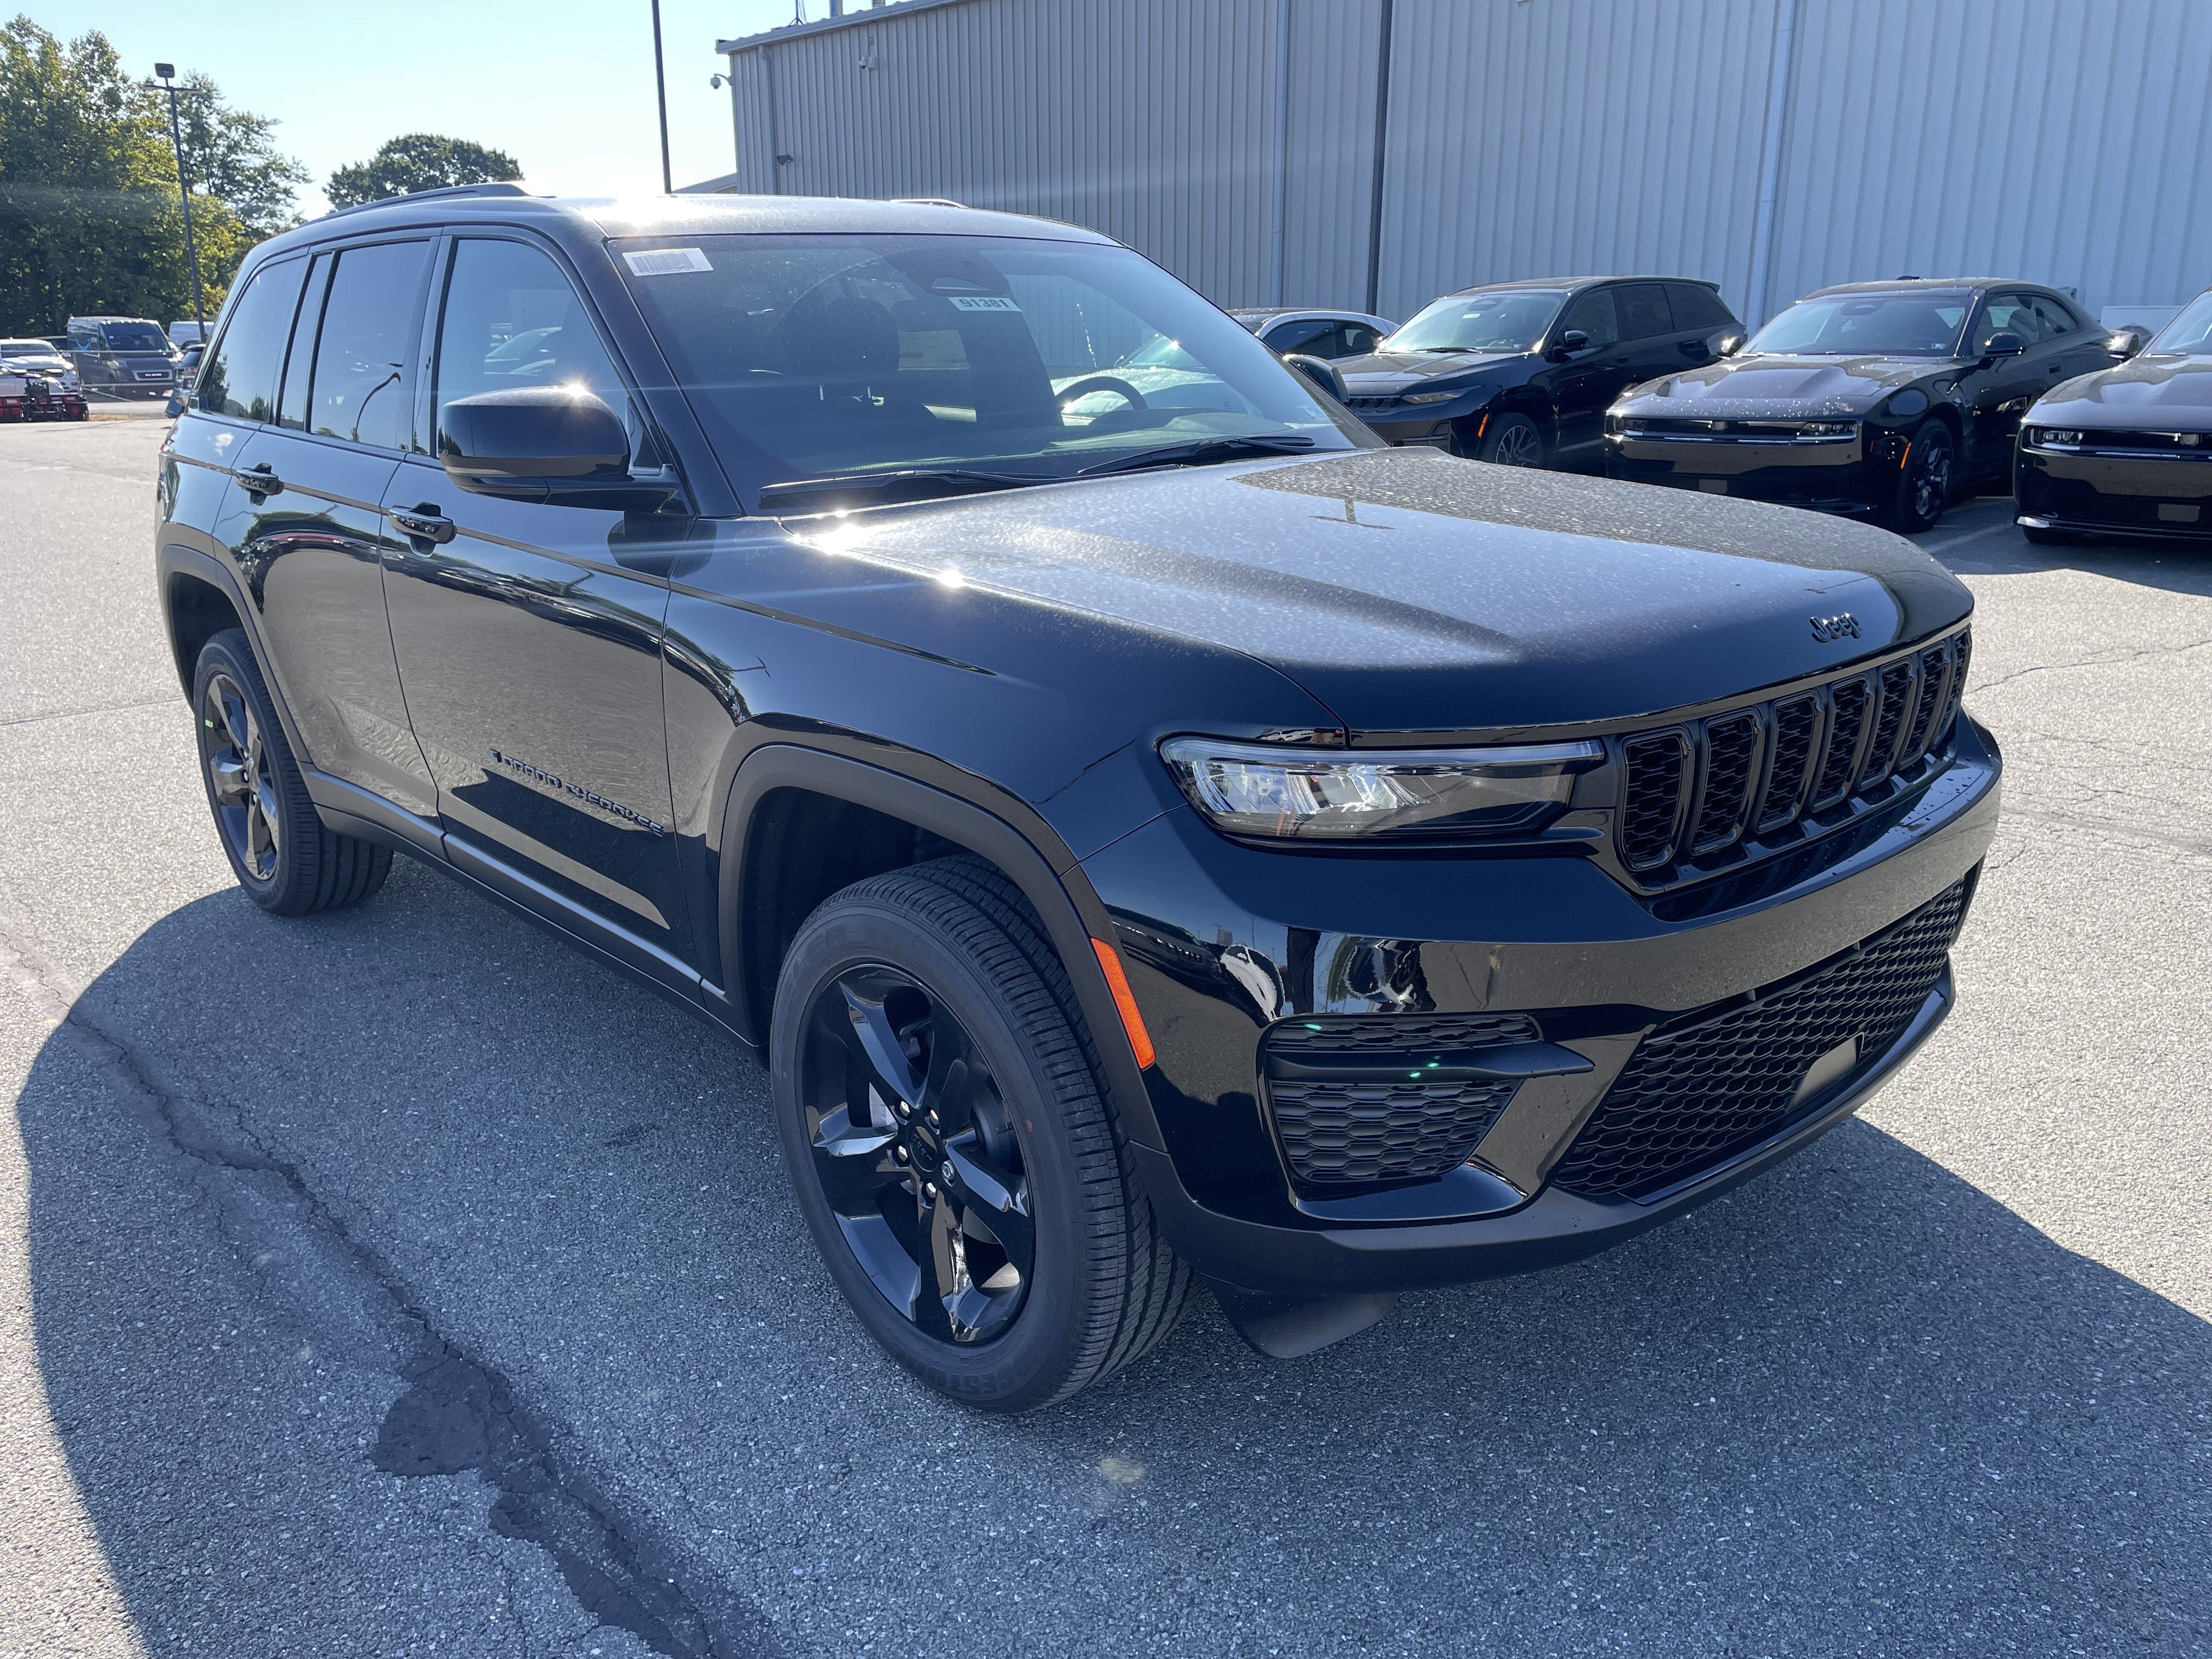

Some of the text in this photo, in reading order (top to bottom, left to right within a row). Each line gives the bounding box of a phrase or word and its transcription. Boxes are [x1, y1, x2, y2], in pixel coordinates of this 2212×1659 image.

[960, 298, 1009, 308] 91381
[1810, 612, 1863, 643] Jeep
[503, 755, 562, 789] GRAND
